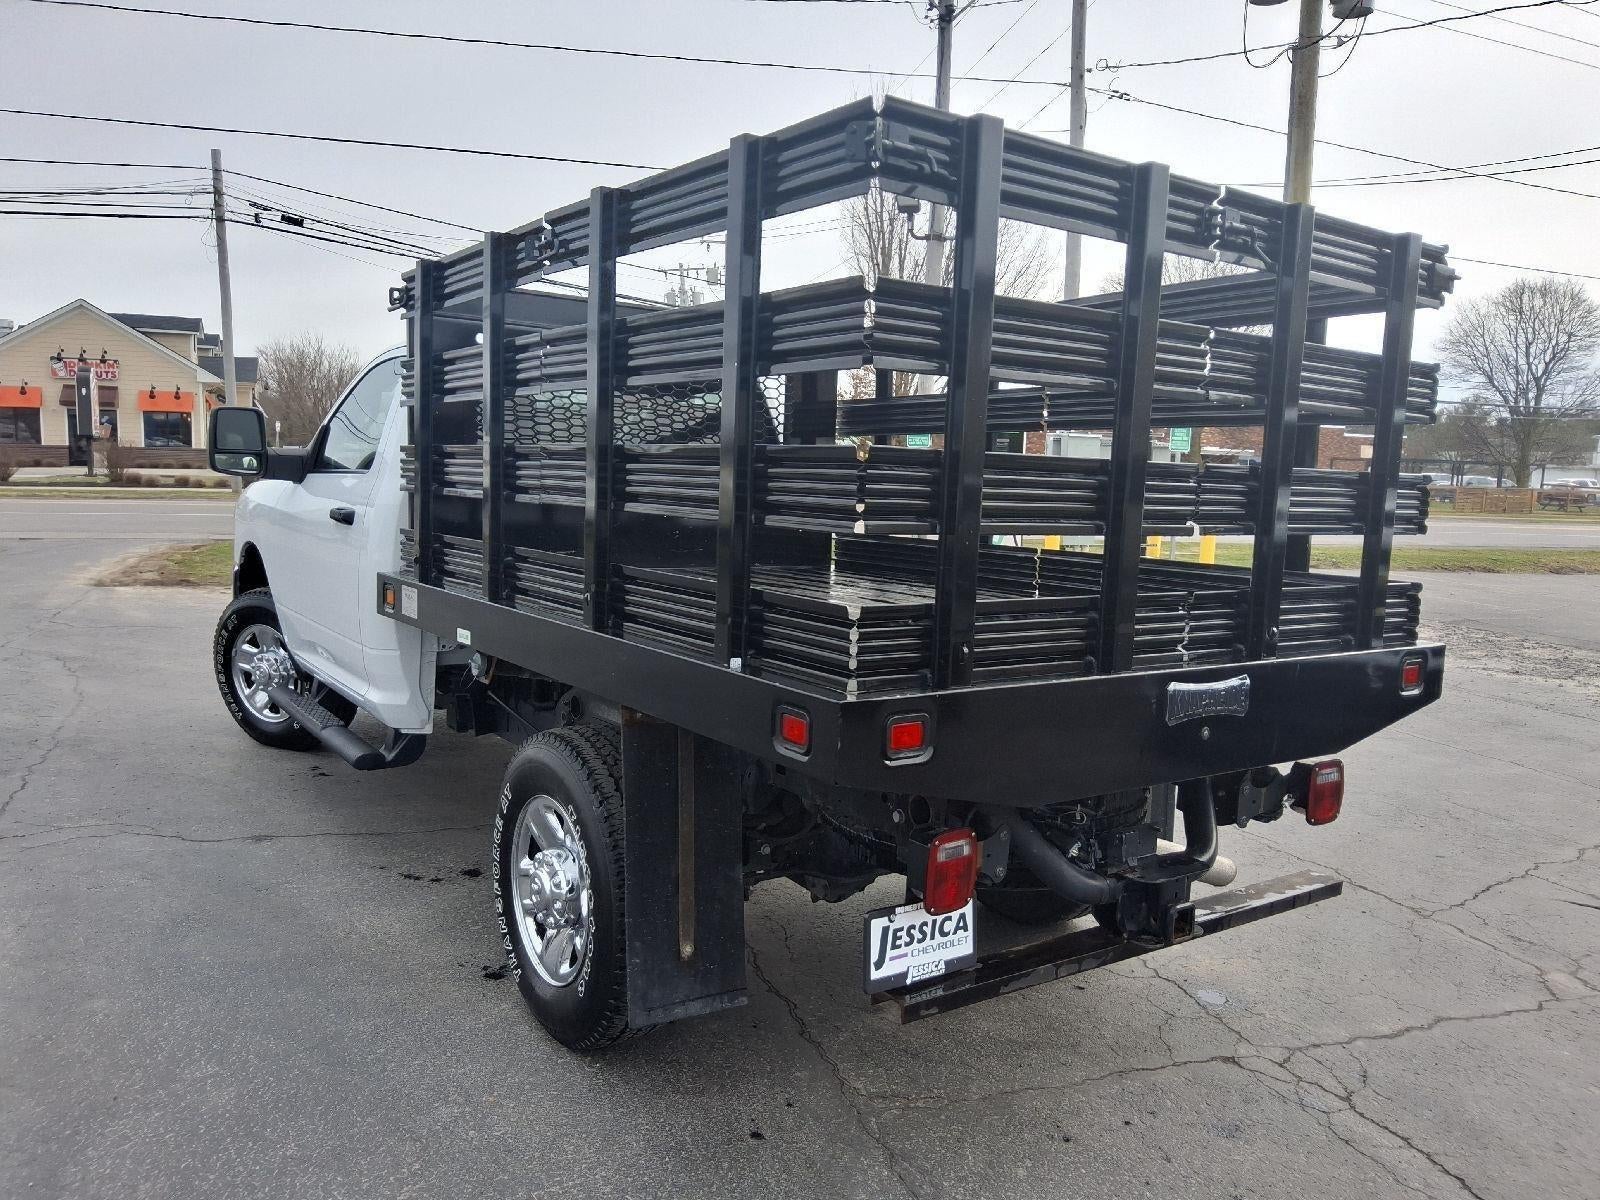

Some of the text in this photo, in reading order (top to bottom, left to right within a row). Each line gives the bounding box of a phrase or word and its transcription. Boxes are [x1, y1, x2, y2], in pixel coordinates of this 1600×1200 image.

[68, 369, 117, 379] DUTS
[492, 782, 522, 983] TRANSFORCE AT
[872, 911, 969, 972] JESSICA
[910, 935, 970, 958] CHEVROLET
[905, 959, 946, 985] JESSICA
